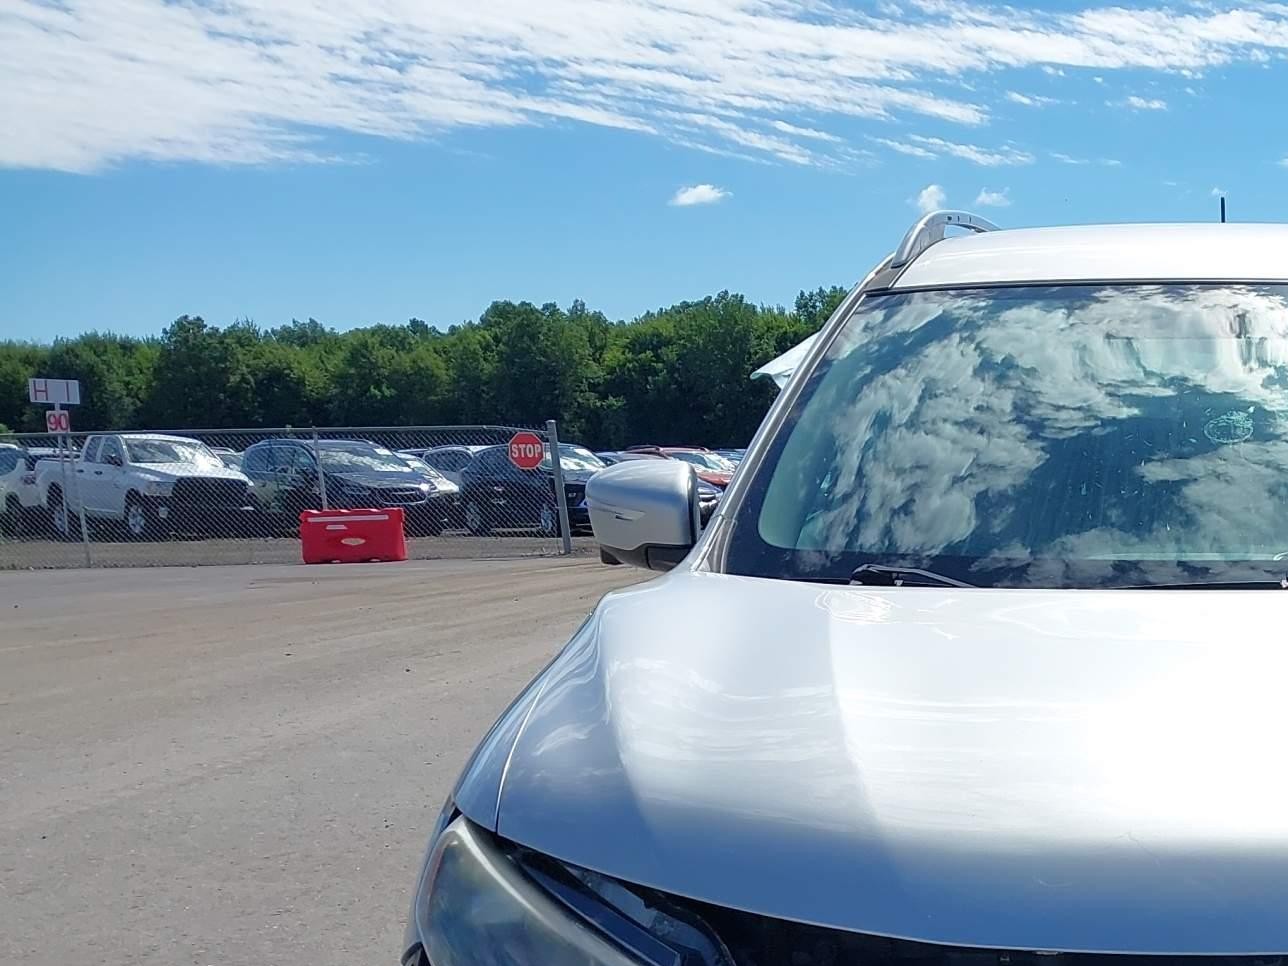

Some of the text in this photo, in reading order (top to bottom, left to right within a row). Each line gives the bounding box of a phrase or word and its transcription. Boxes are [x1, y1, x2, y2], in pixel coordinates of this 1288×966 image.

[33, 379, 49, 401] H
[47, 412, 69, 431] 90
[511, 443, 542, 458] STOP
